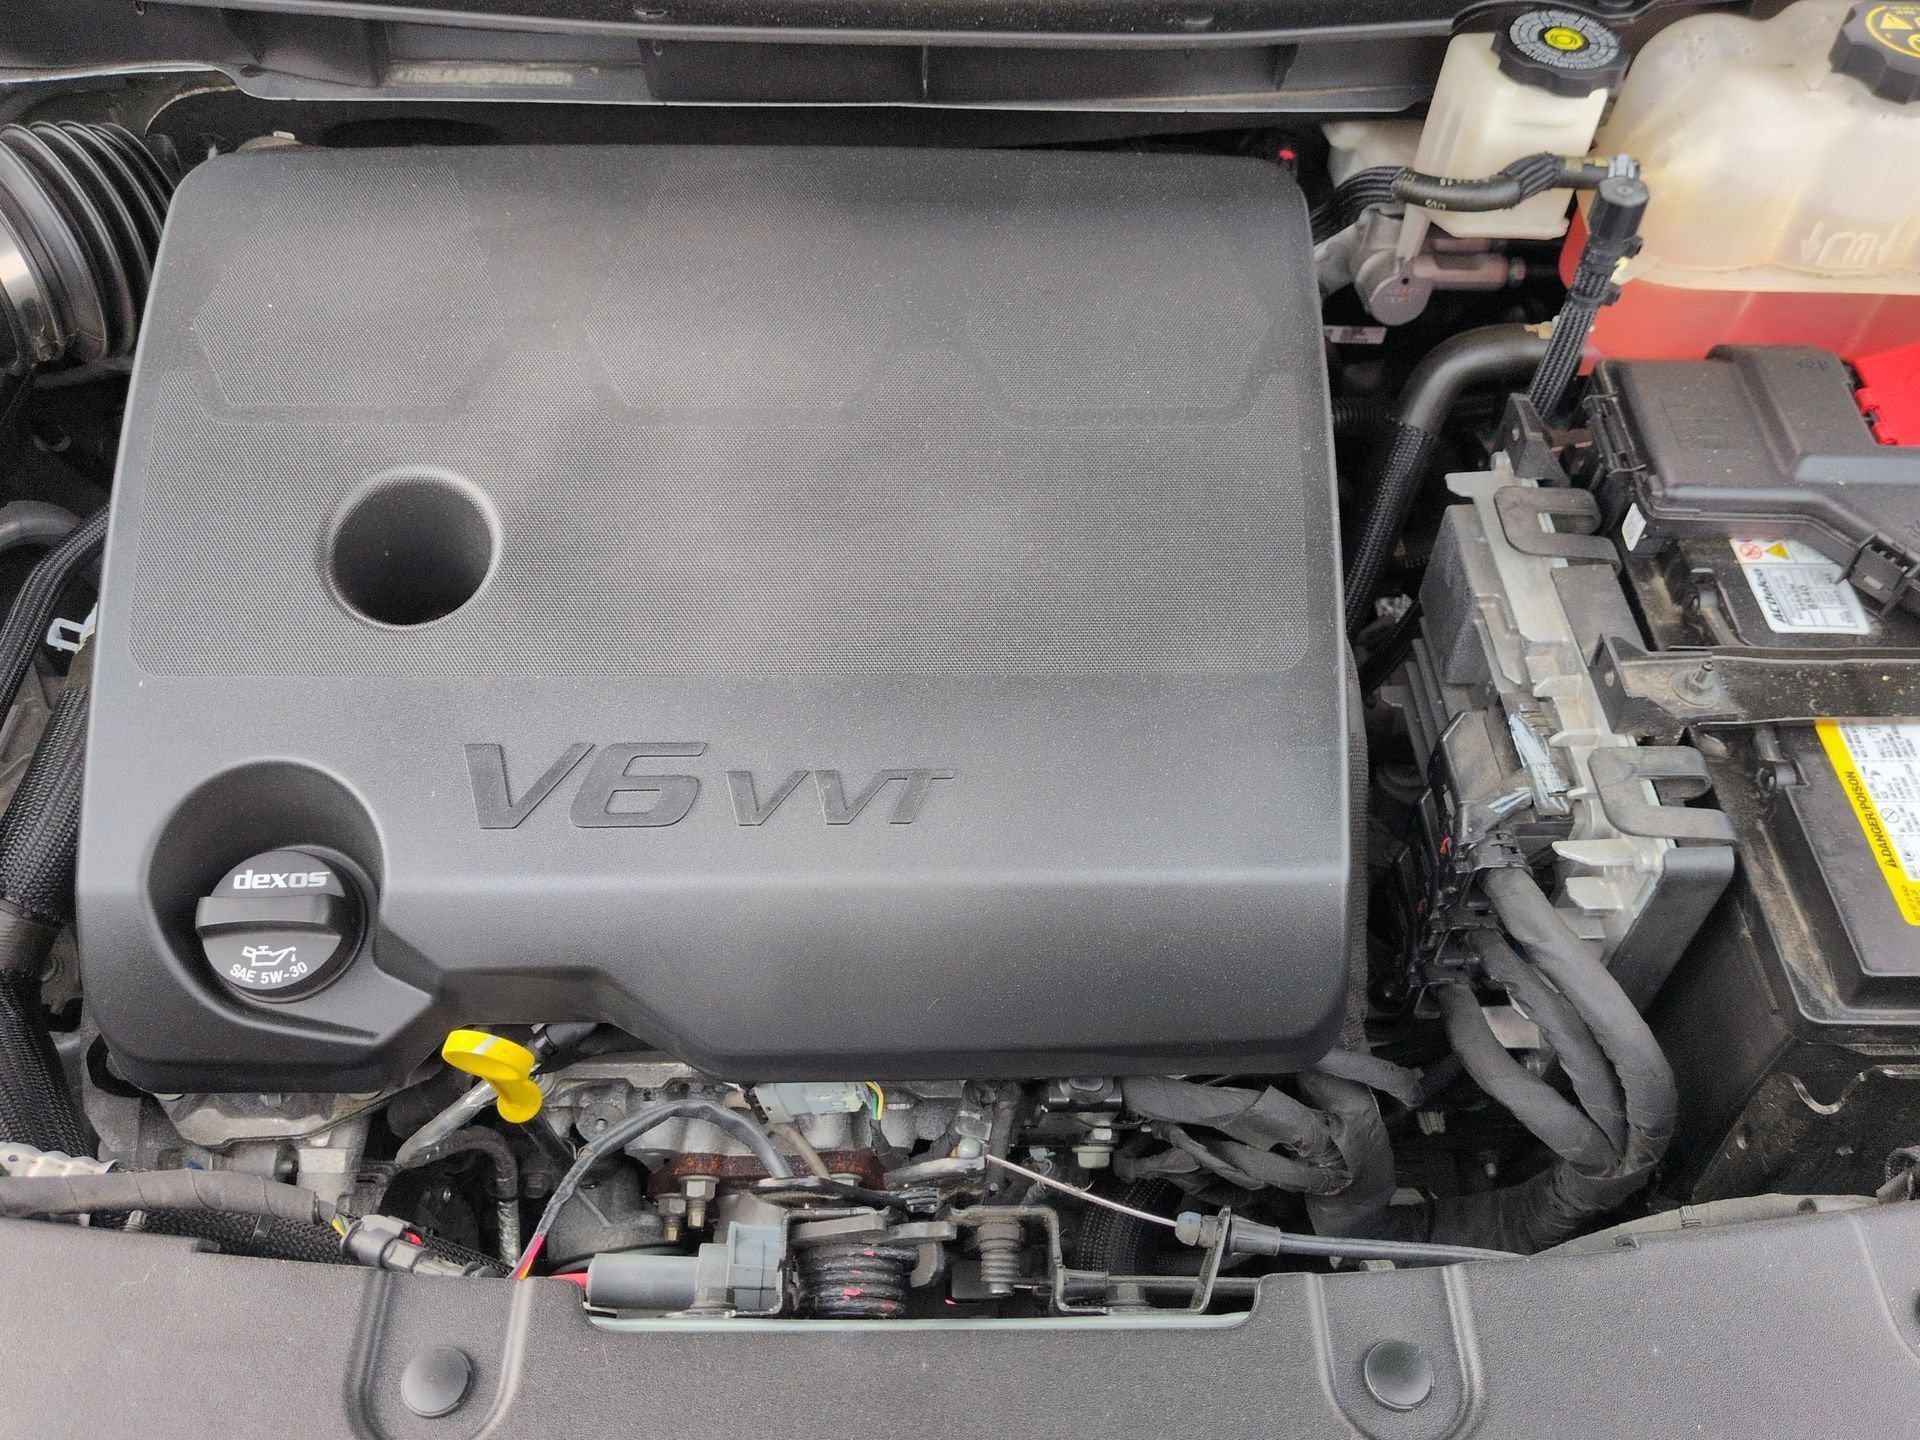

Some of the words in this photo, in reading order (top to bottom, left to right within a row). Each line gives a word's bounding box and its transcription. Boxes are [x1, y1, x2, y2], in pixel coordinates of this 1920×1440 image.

[1753, 568, 1787, 624] ACDelco
[464, 742, 708, 829] V6
[726, 769, 956, 826] VVT
[233, 869, 331, 890] dexos
[229, 963, 257, 983] SAE
[260, 961, 308, 984] 5W-30
